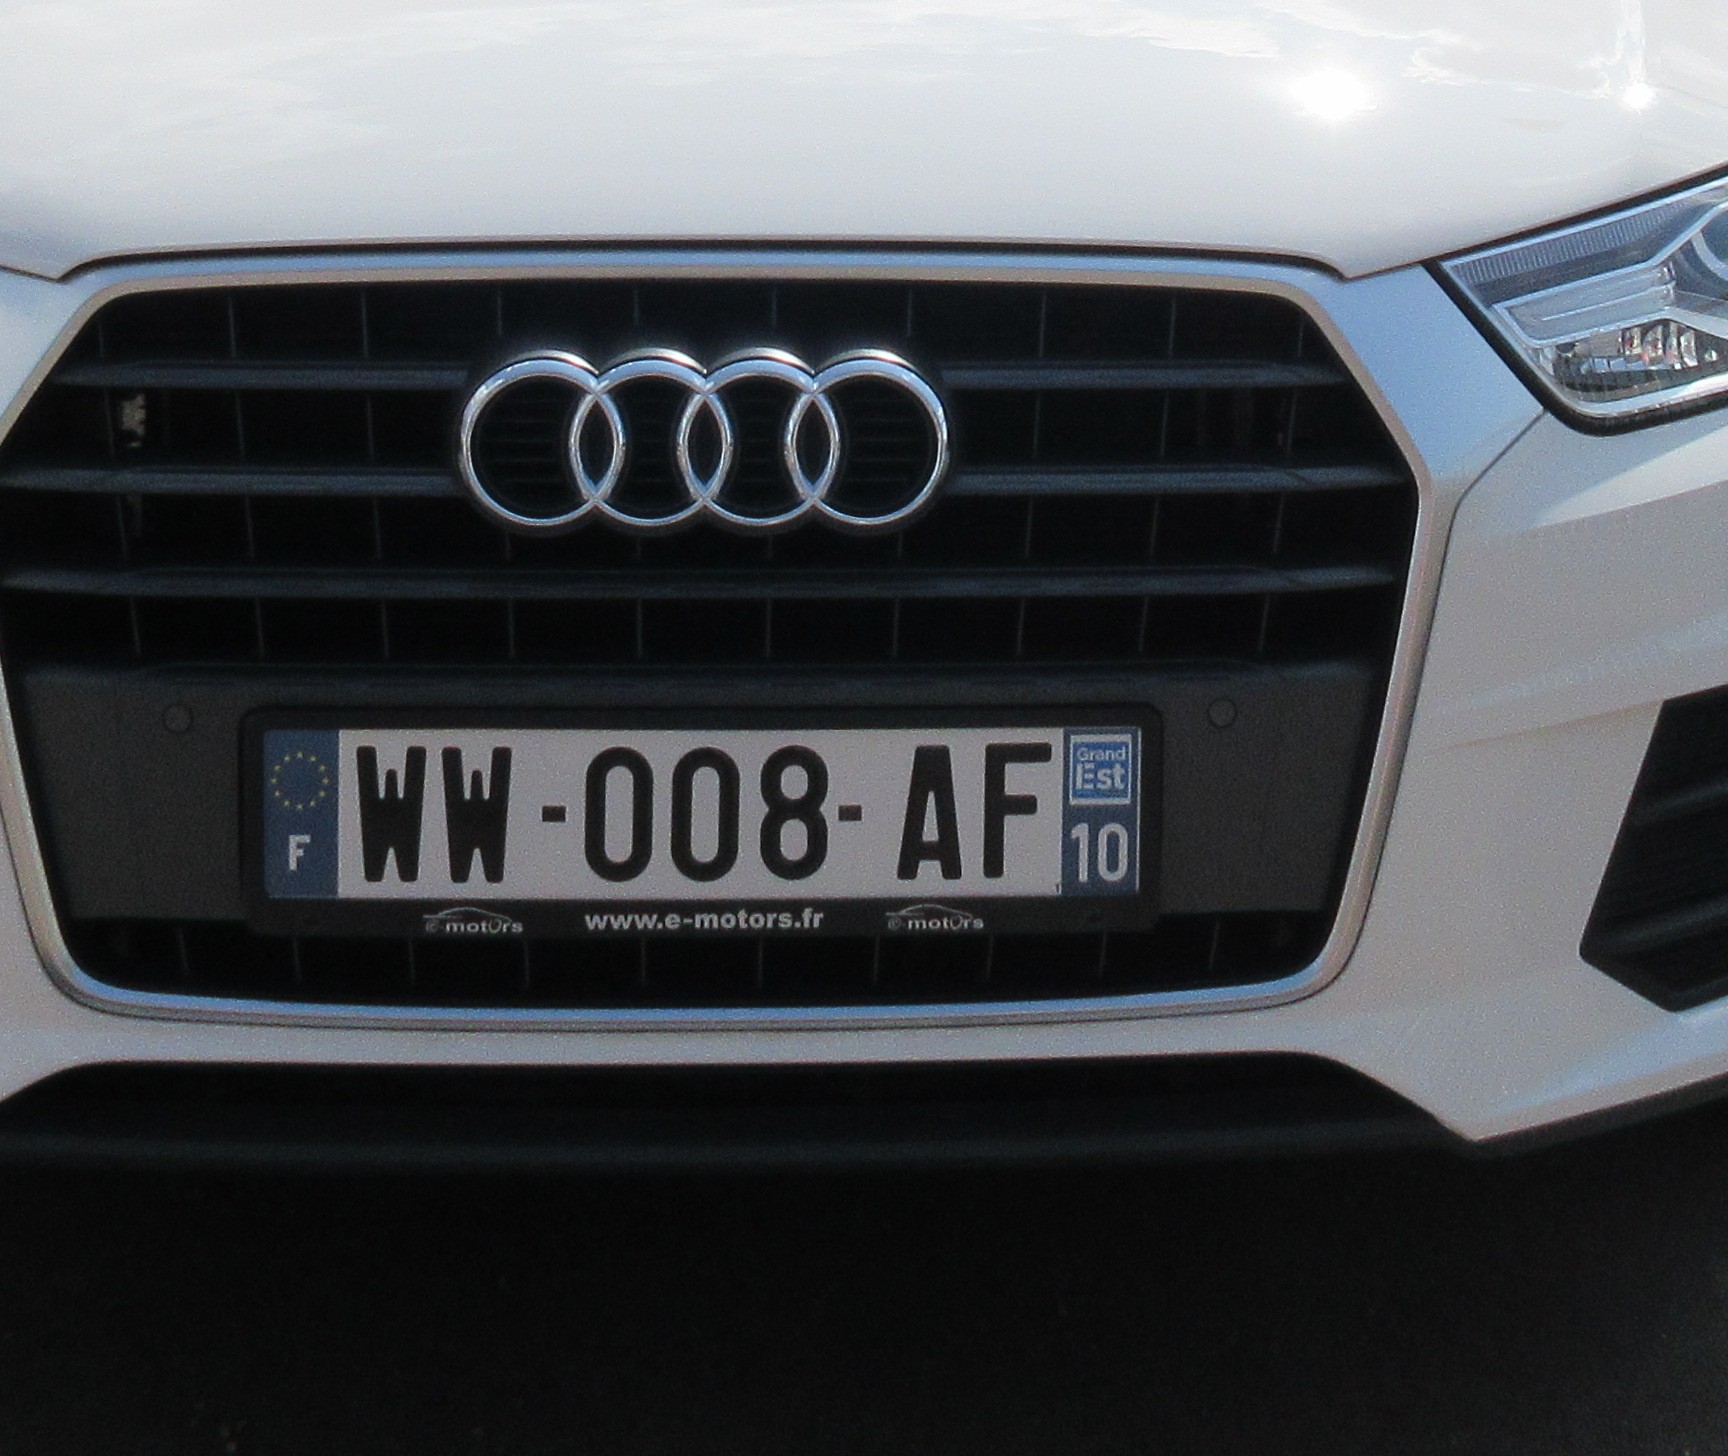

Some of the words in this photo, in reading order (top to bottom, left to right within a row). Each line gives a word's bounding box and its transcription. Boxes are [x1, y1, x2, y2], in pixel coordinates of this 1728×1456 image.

[1076, 746, 1127, 762] Grand
[1075, 762, 1126, 790] Est
[288, 833, 312, 871] F
[1071, 822, 1129, 883] 10
[584, 907, 825, 931] www.e-motors.fr
